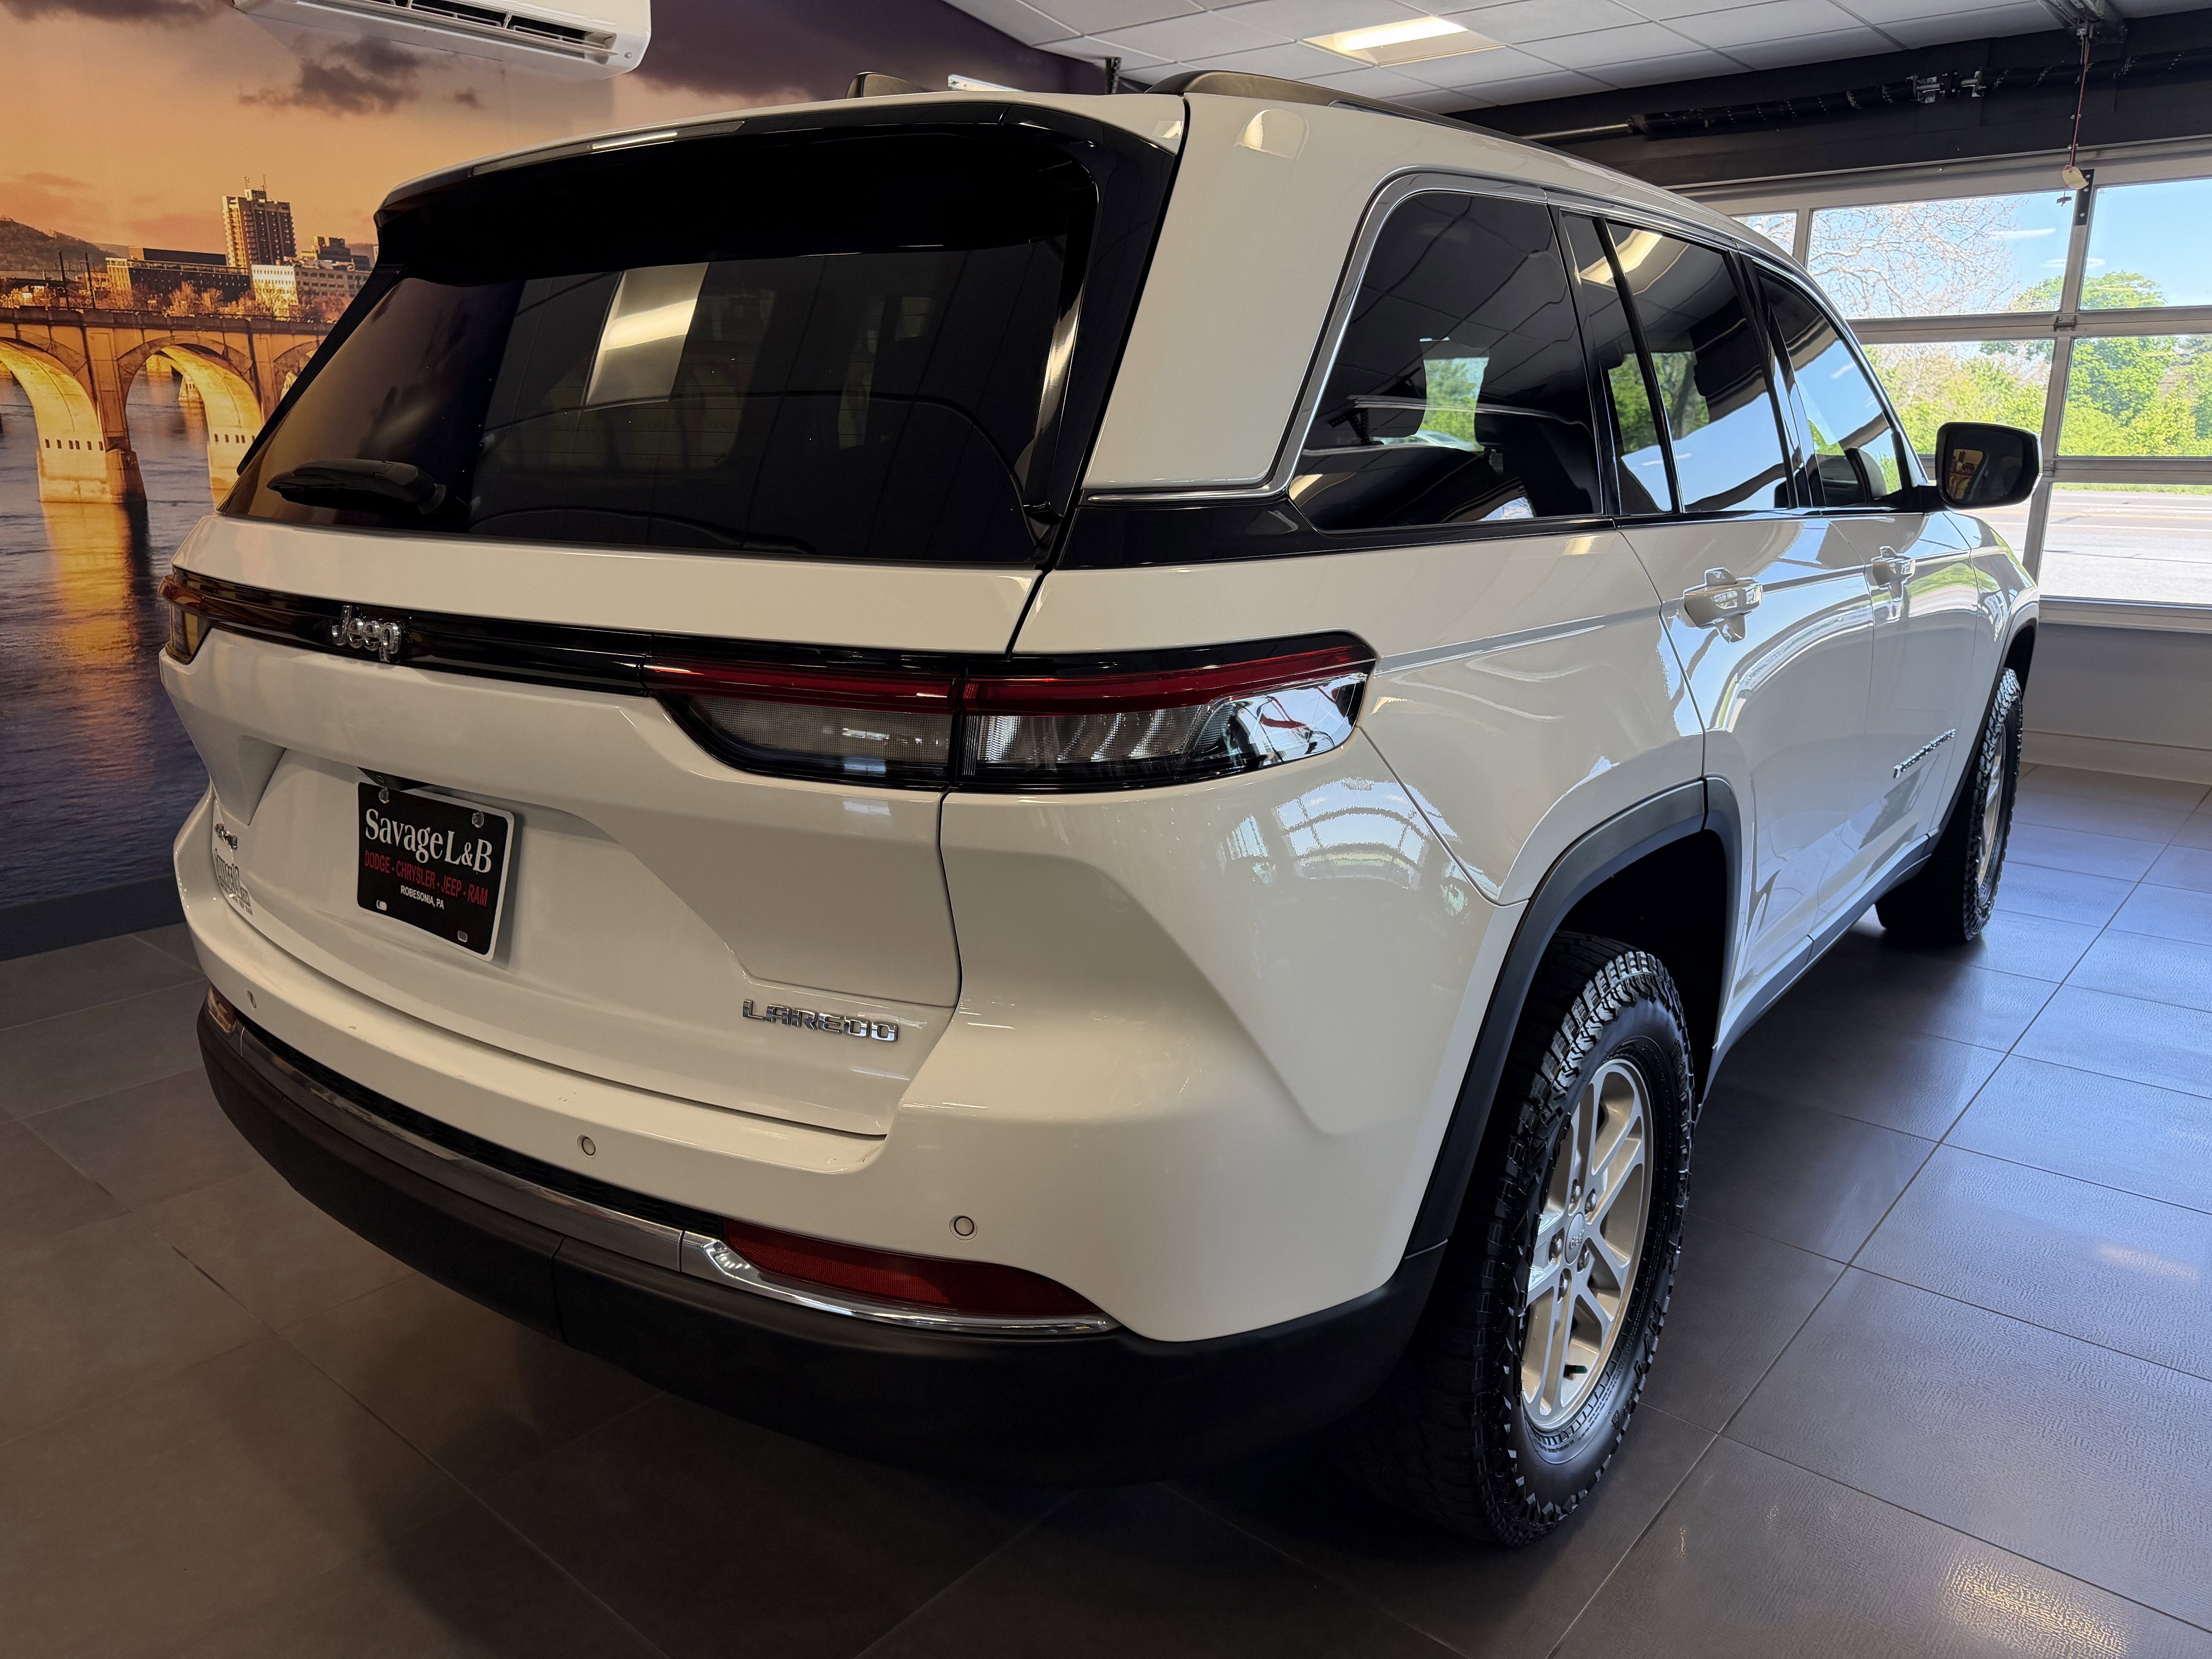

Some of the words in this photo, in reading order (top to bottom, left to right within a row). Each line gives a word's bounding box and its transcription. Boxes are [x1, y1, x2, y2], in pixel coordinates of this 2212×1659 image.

[332, 605, 401, 663] Jeep
[365, 850, 390, 874] DODGE
[396, 860, 435, 889] CHRYSLER
[441, 876, 462, 897] JEEP
[467, 884, 488, 907] RAM
[400, 885, 435, 908] ROBESONIA,
[436, 898, 444, 909] PA
[743, 999, 899, 1042] LAREDO
